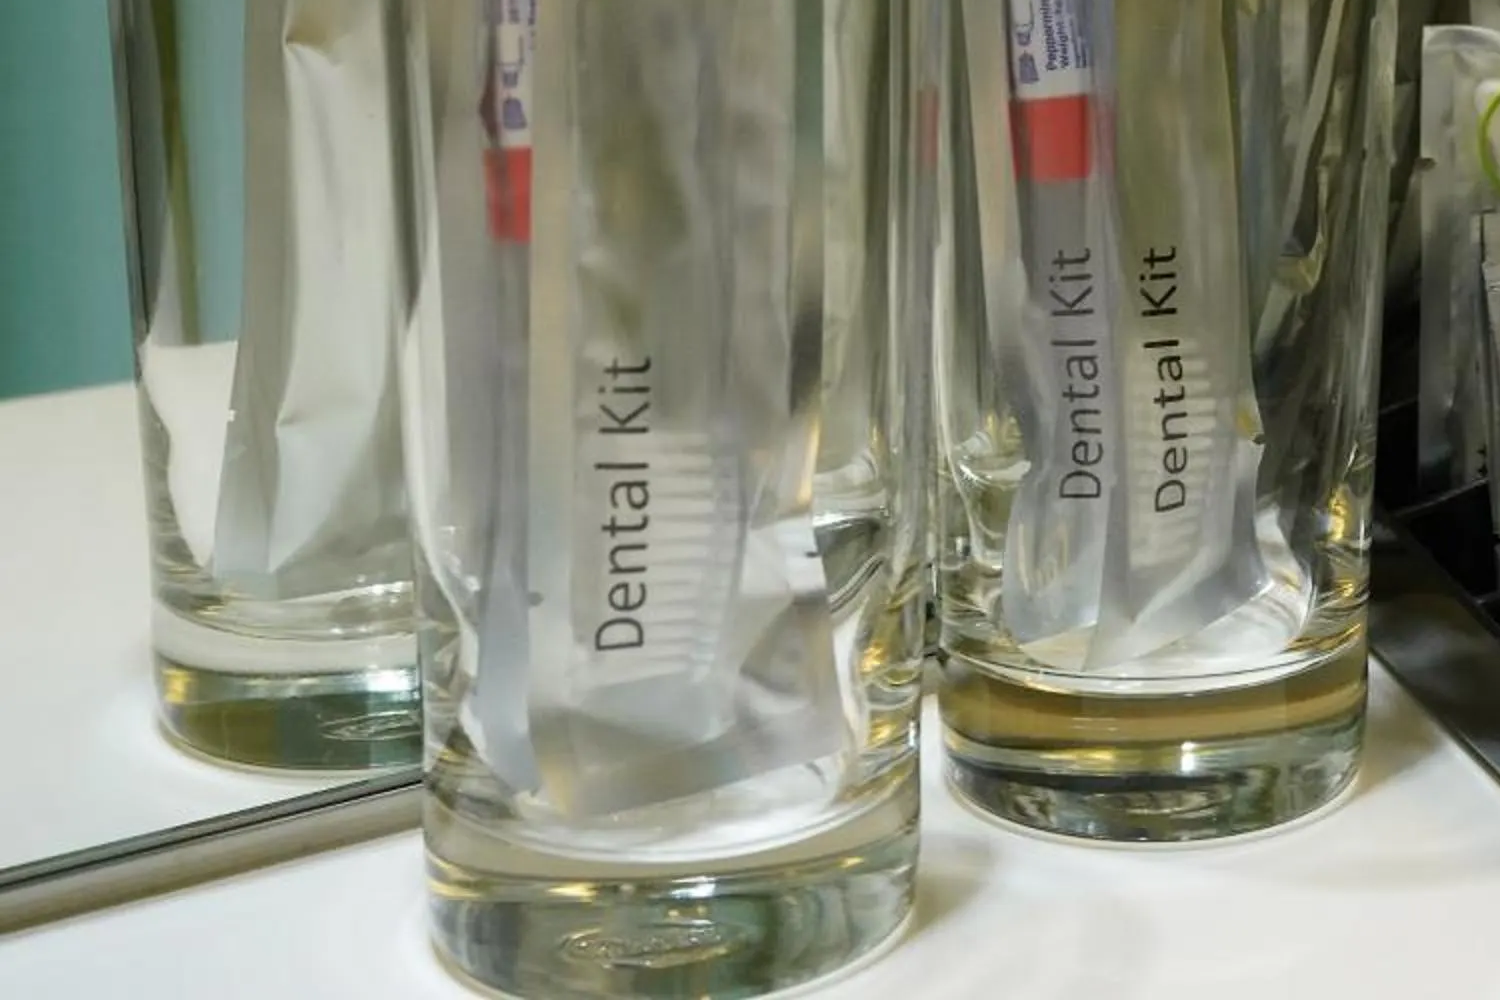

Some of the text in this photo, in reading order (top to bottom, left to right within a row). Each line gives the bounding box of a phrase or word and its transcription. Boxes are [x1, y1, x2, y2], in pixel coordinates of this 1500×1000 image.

[594, 356, 652, 652] Dental Kit
[1049, 248, 1104, 500] Dental Kit
[1139, 246, 1188, 513] Dental Kit
